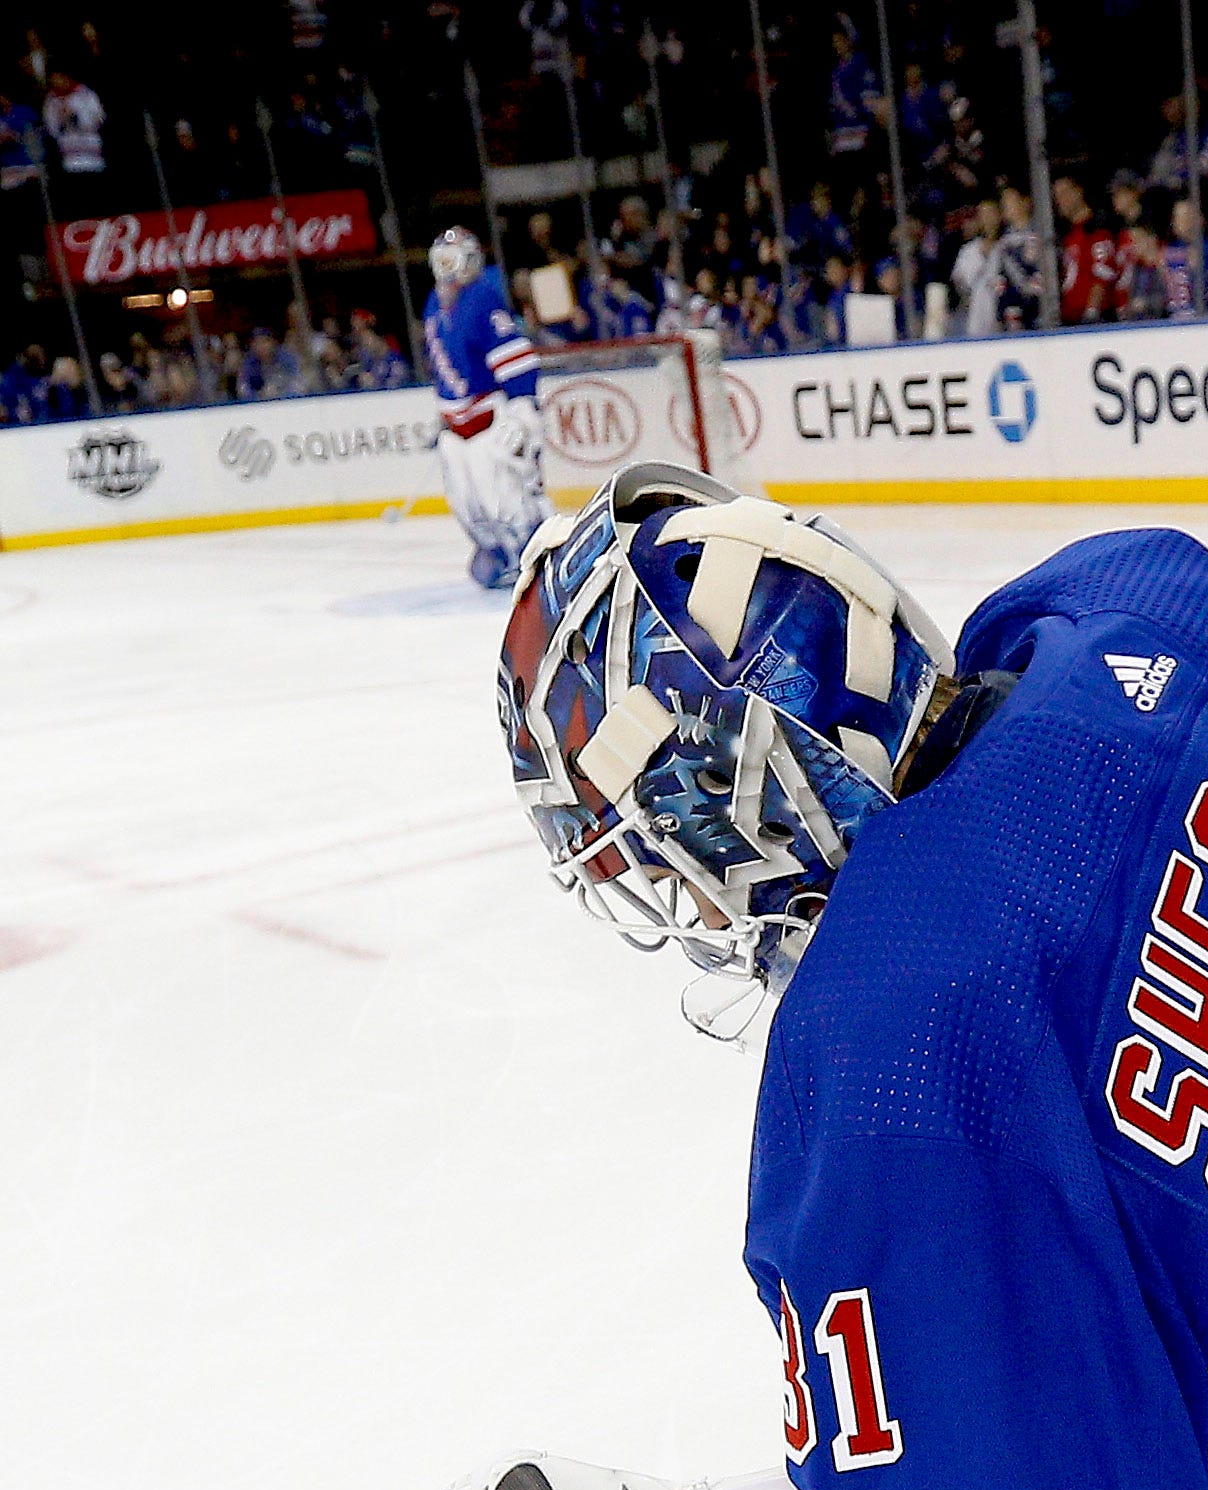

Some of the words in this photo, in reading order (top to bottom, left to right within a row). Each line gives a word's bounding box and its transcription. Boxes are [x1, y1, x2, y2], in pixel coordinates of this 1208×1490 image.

[63, 209, 352, 285] Budweiser
[557, 400, 627, 445] KIA
[793, 371, 973, 438] CHASE
[1134, 654, 1179, 713] adidas
